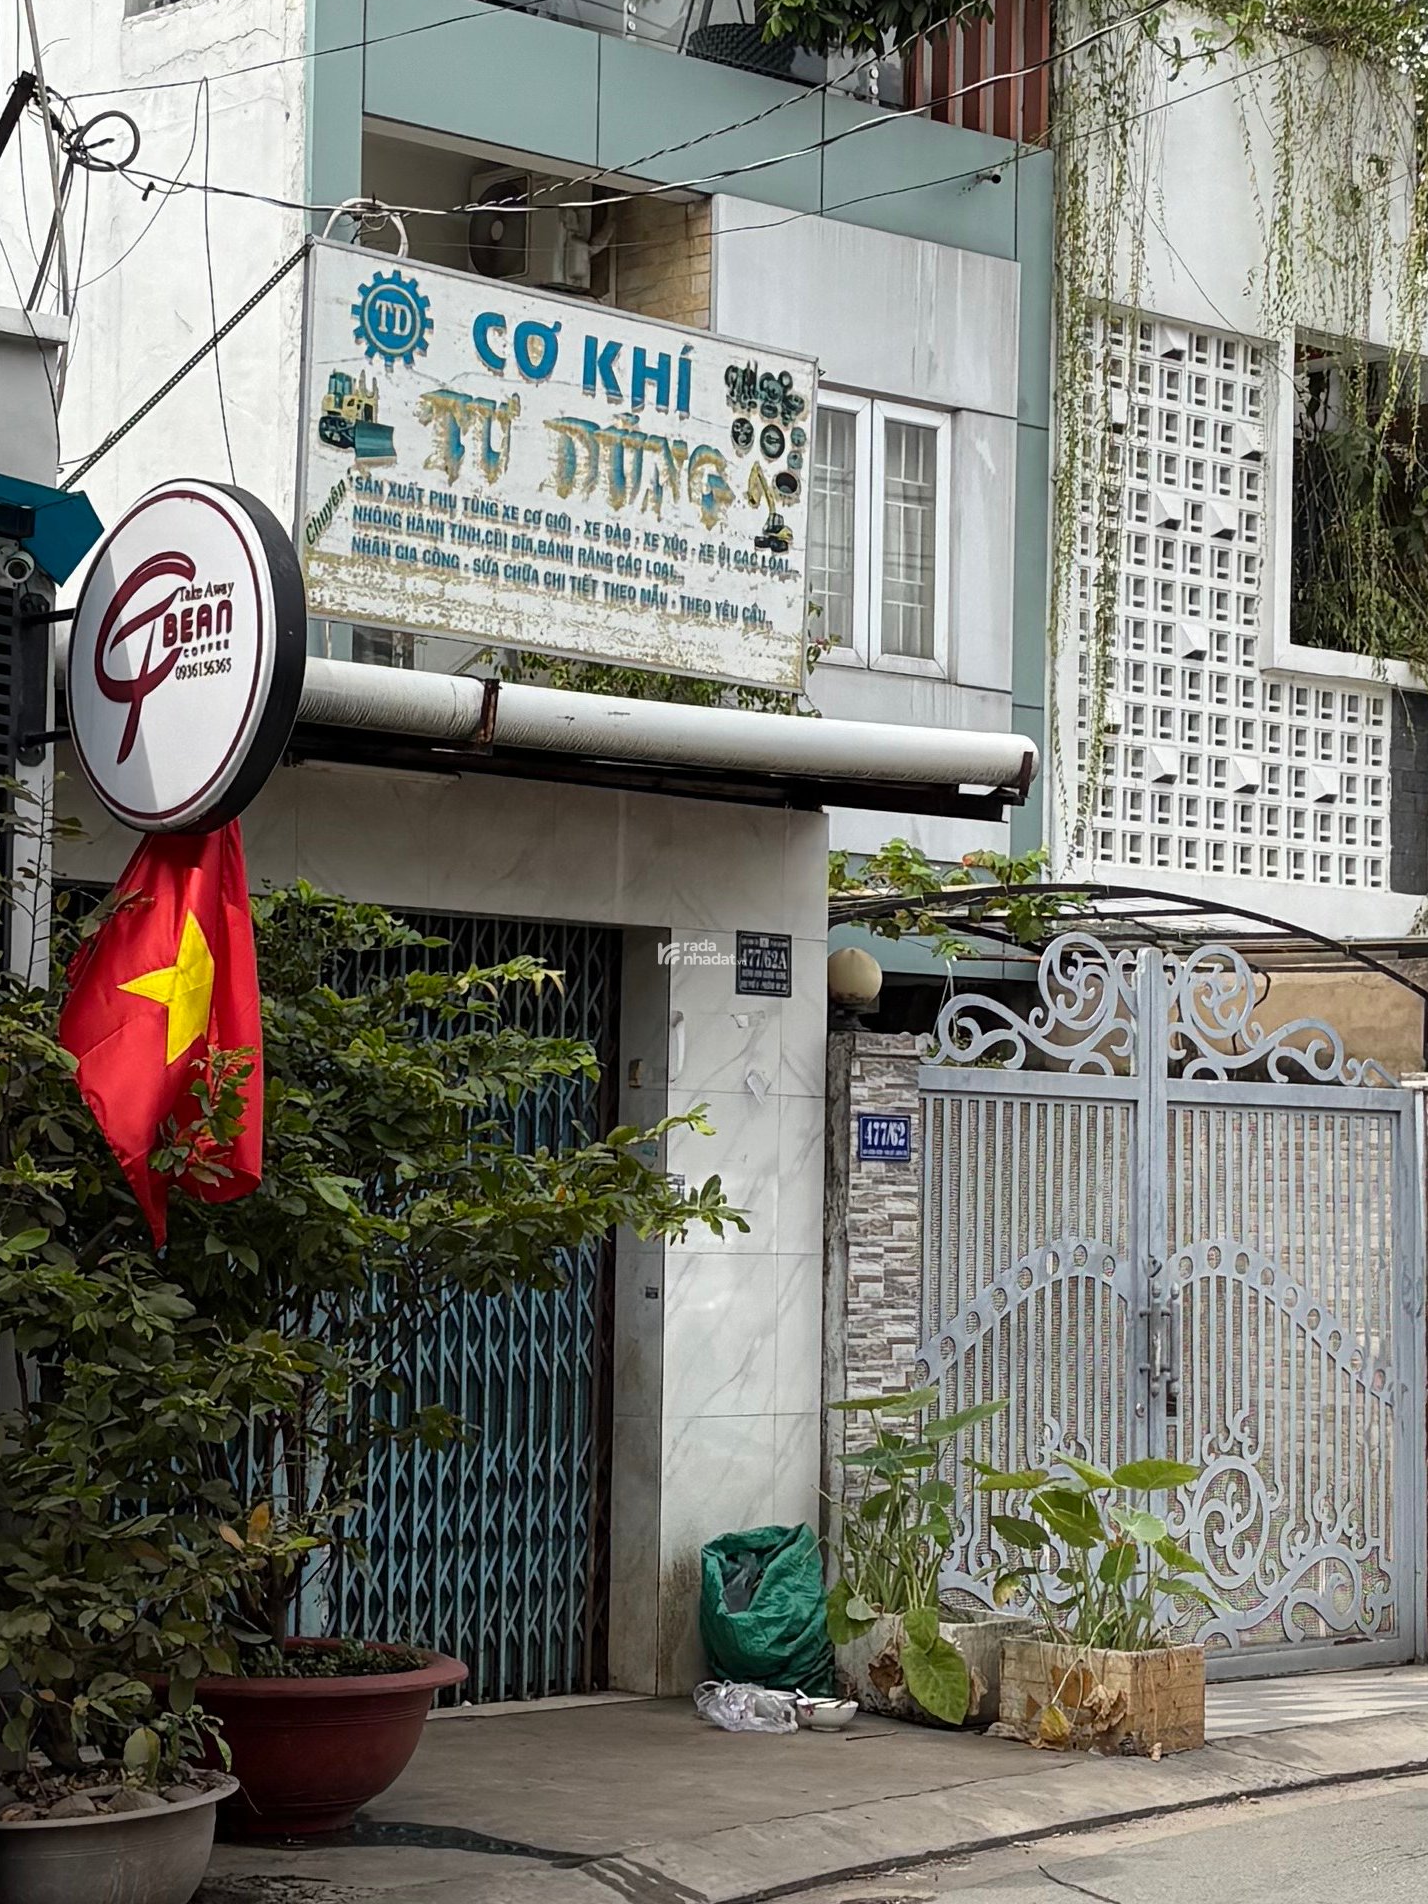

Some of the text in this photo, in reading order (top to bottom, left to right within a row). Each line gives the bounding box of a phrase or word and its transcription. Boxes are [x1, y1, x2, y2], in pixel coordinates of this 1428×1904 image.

[374, 300, 413, 337] TD
[472, 311, 695, 418] CƠ KHÍ
[502, 504, 519, 520] XE
[524, 508, 542, 524] CƠ
[584, 519, 601, 536] XE
[644, 532, 659, 548] XE
[699, 542, 716, 558] XE
[204, 581, 234, 598] Away
[422, 547, 460, 569] CÔNG
[543, 571, 566, 591] CHI
[602, 581, 636, 603] THEO
[679, 594, 711, 614] THEO
[163, 599, 233, 648] BEAN
[184, 639, 229, 658] COFFEE
[864, 1121, 906, 1146] 477/62
